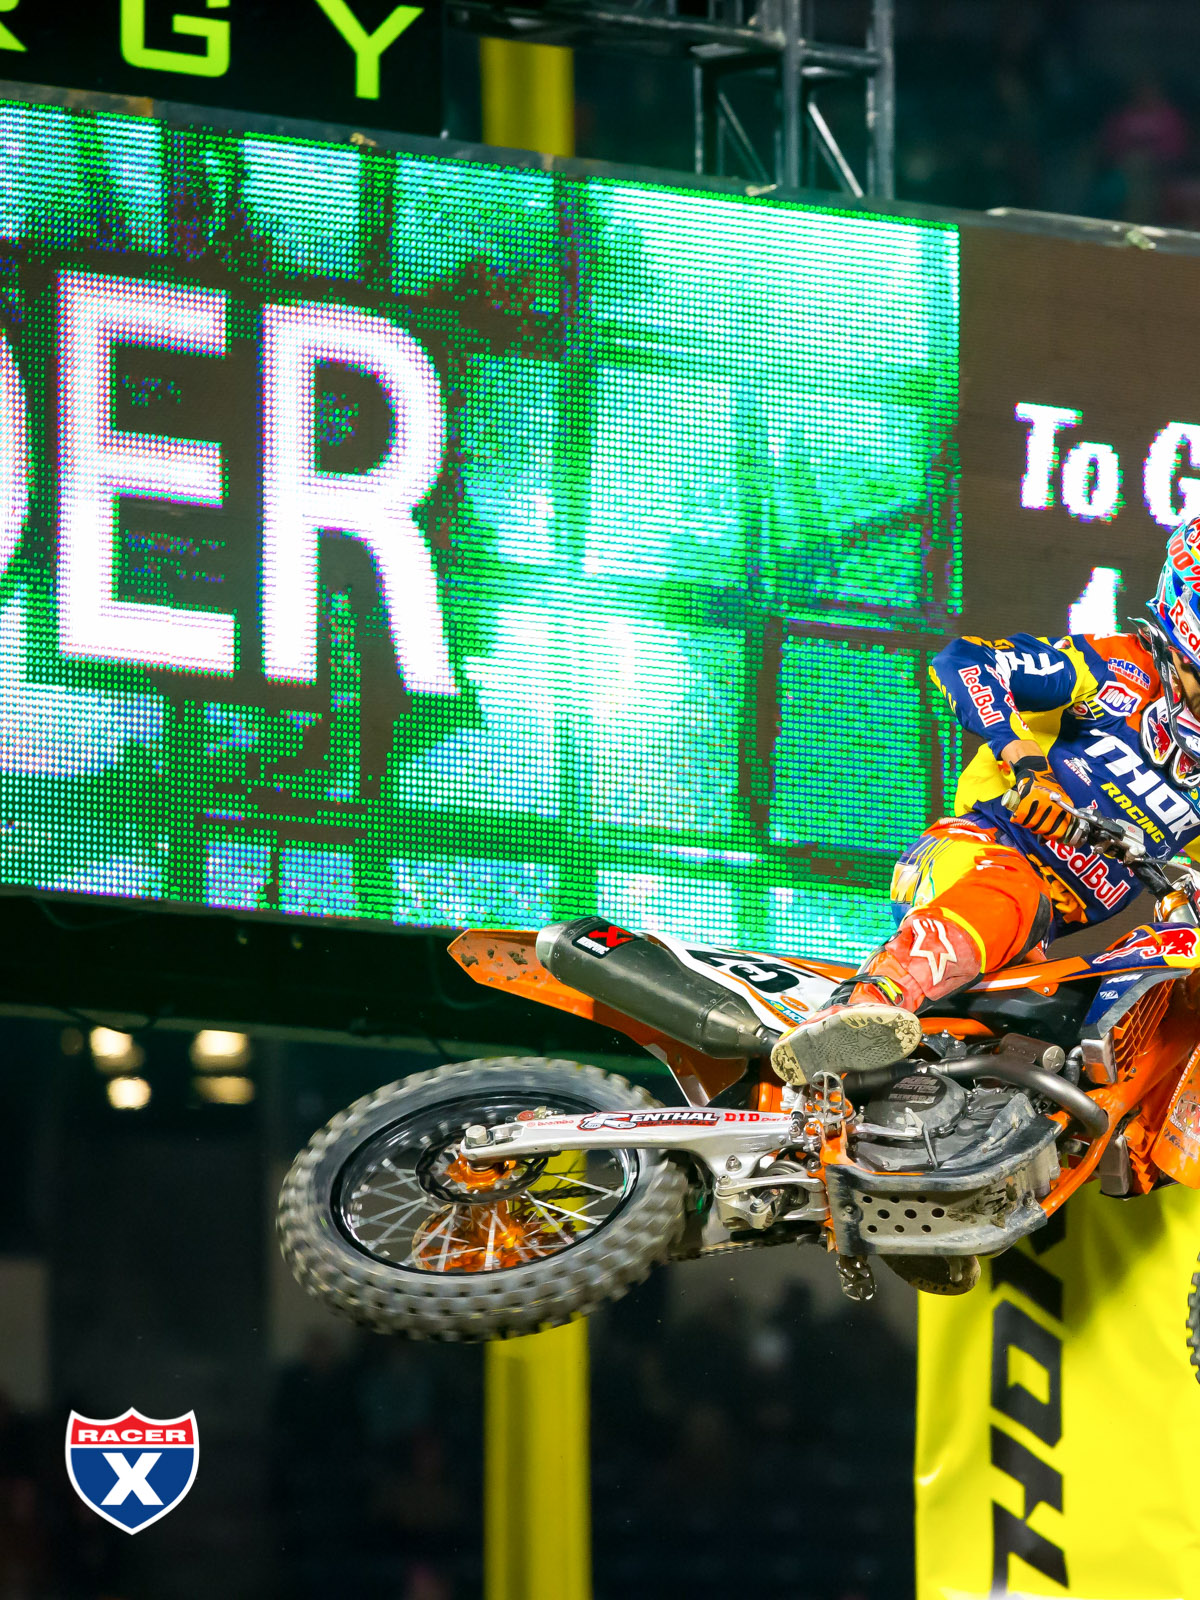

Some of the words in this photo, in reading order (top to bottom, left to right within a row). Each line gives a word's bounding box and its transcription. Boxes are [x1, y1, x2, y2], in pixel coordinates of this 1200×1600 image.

[0, 0, 424, 99] GY
[0, 269, 460, 697] ER
[1014, 402, 1124, 522] To
[1108, 657, 1151, 685] PARTS
[1101, 687, 1136, 712] 100%
[1100, 781, 1166, 844] RACING
[581, 1112, 718, 1129] RENTHAL
[724, 1112, 760, 1122] DID
